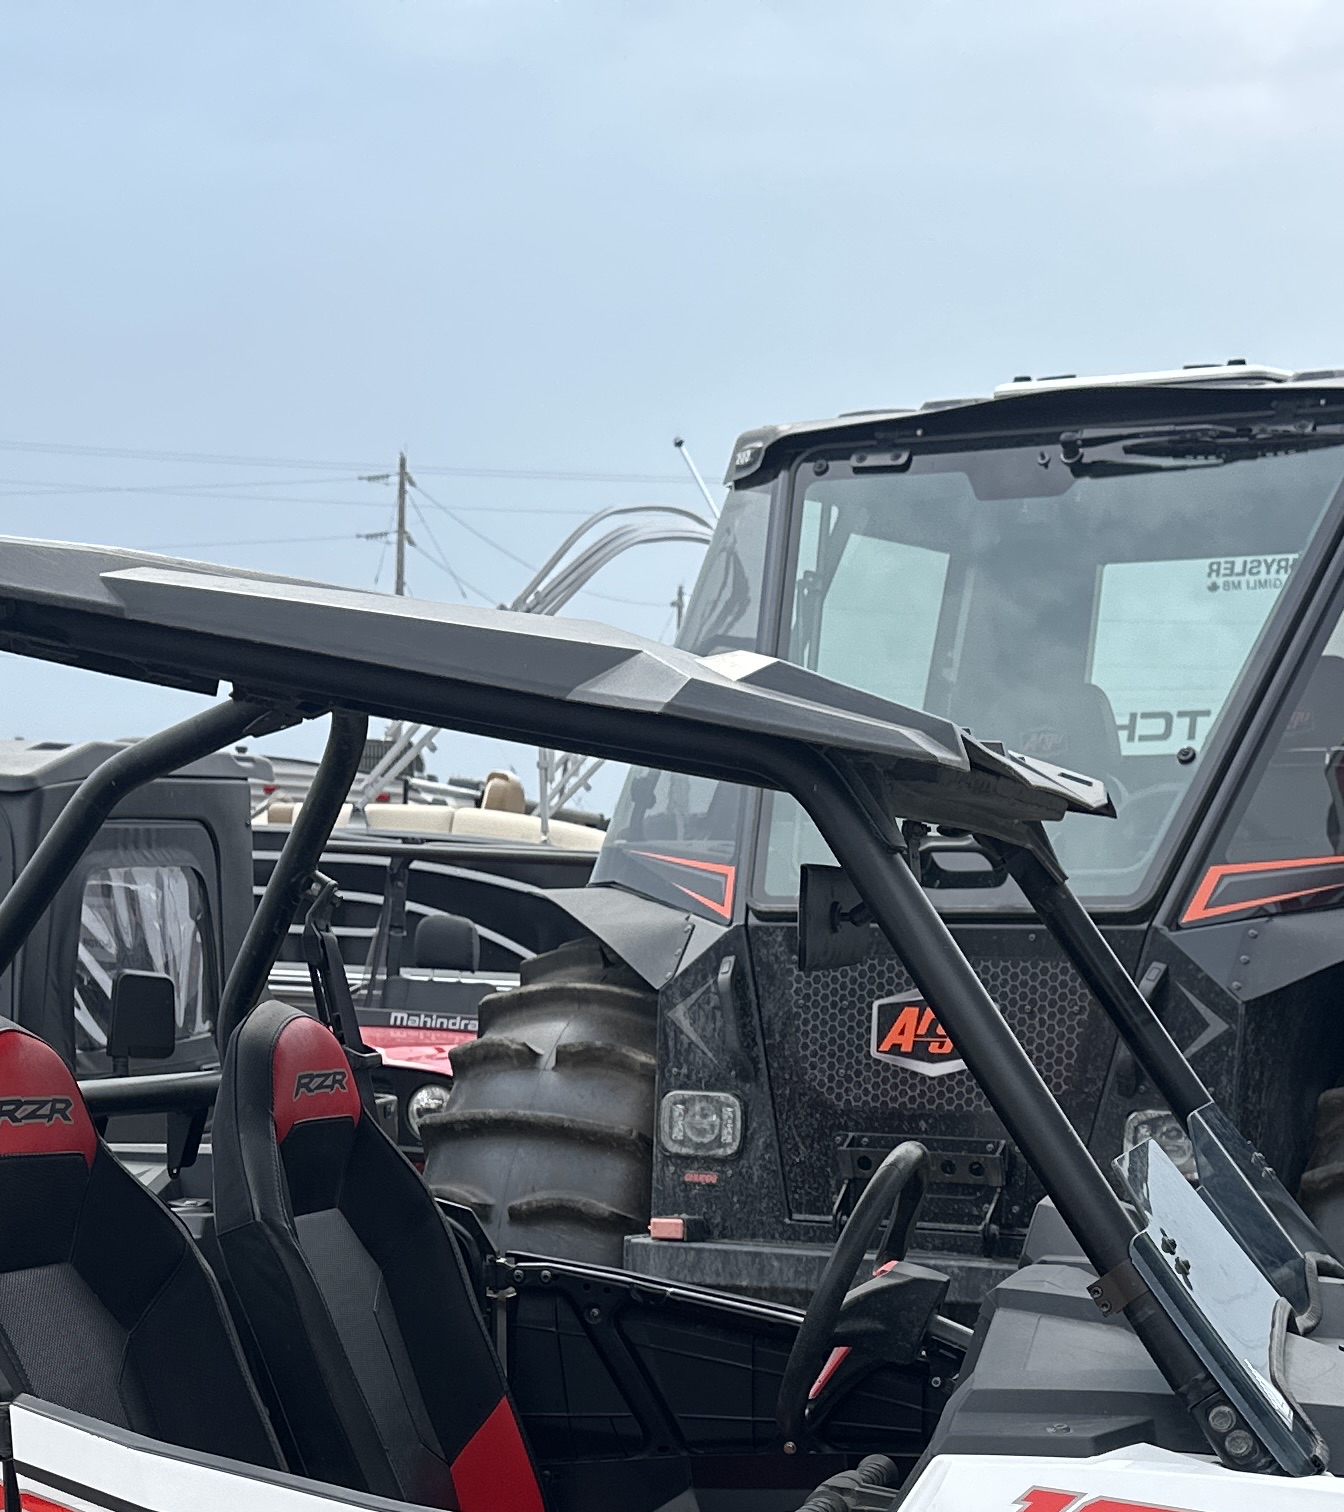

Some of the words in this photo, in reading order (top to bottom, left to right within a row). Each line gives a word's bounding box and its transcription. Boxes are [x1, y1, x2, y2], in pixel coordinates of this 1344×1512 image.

[389, 1011, 479, 1031] Mahindra
[878, 1006, 954, 1054] Ar
[291, 1067, 349, 1102] RZR
